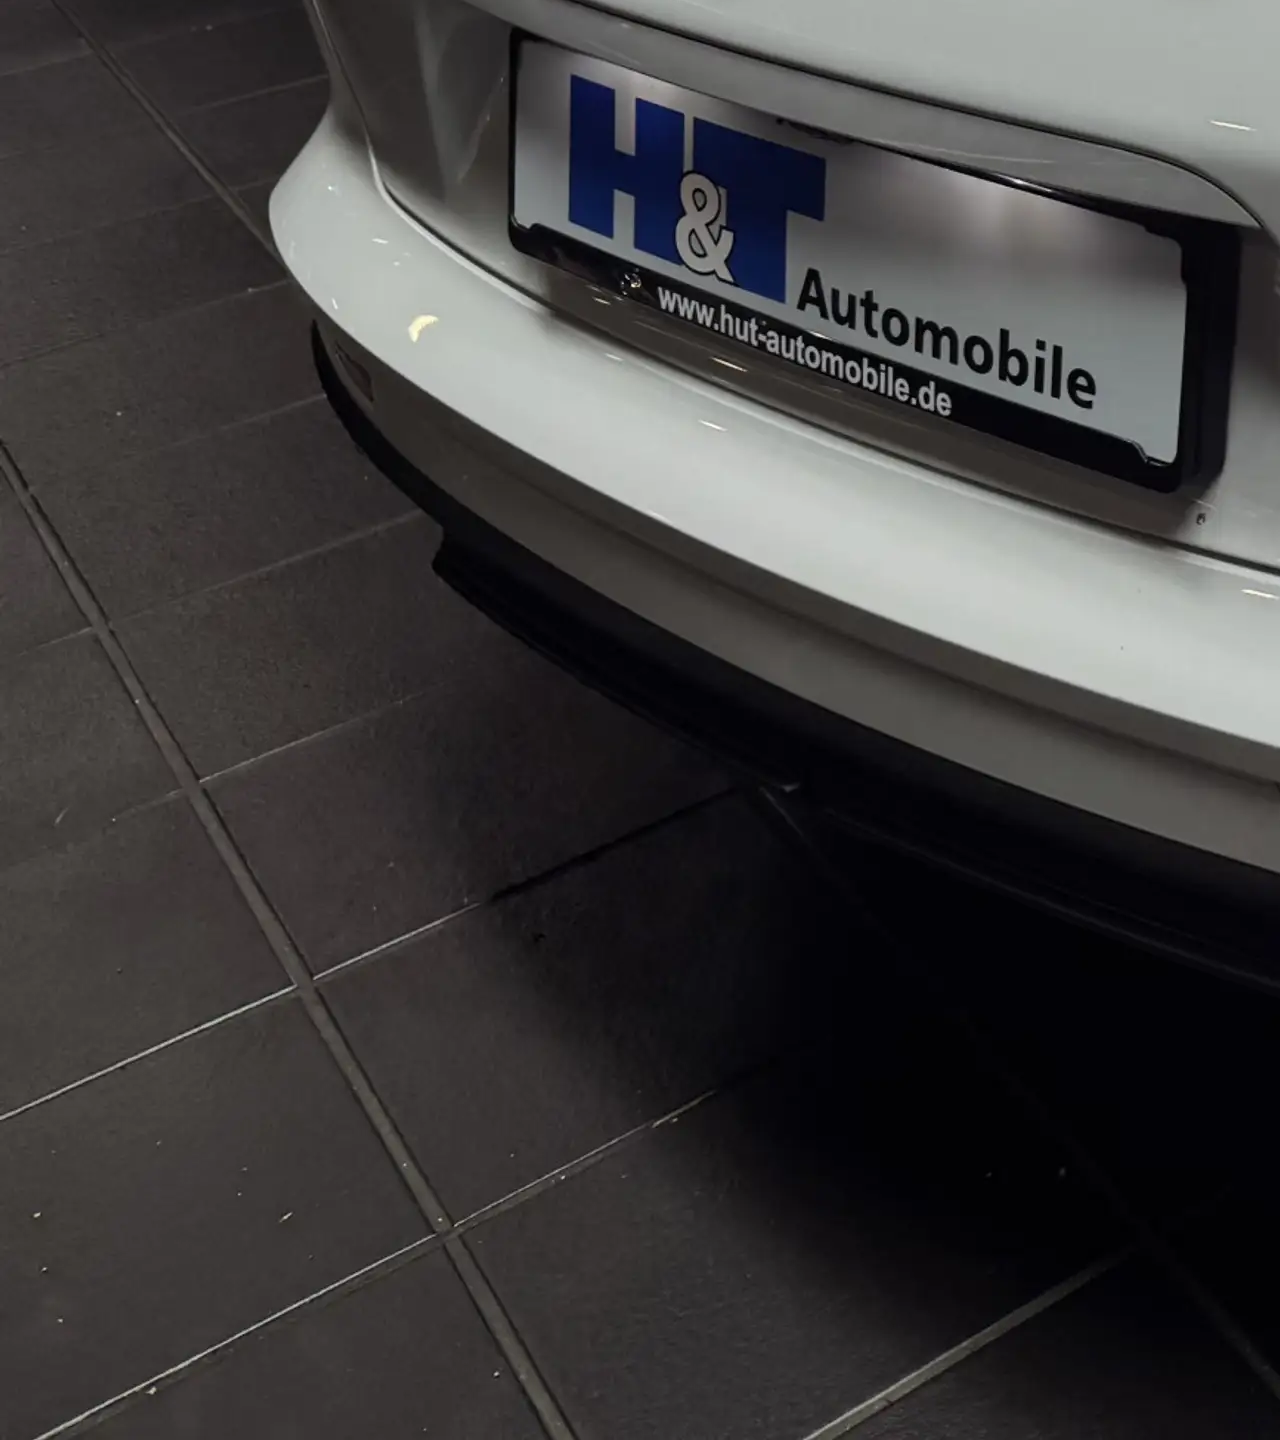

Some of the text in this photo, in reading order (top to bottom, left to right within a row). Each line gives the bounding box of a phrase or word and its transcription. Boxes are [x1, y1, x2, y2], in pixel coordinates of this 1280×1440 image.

[568, 73, 1097, 410] H&T Automobile
[657, 285, 953, 418] www.hut-automobile.de
